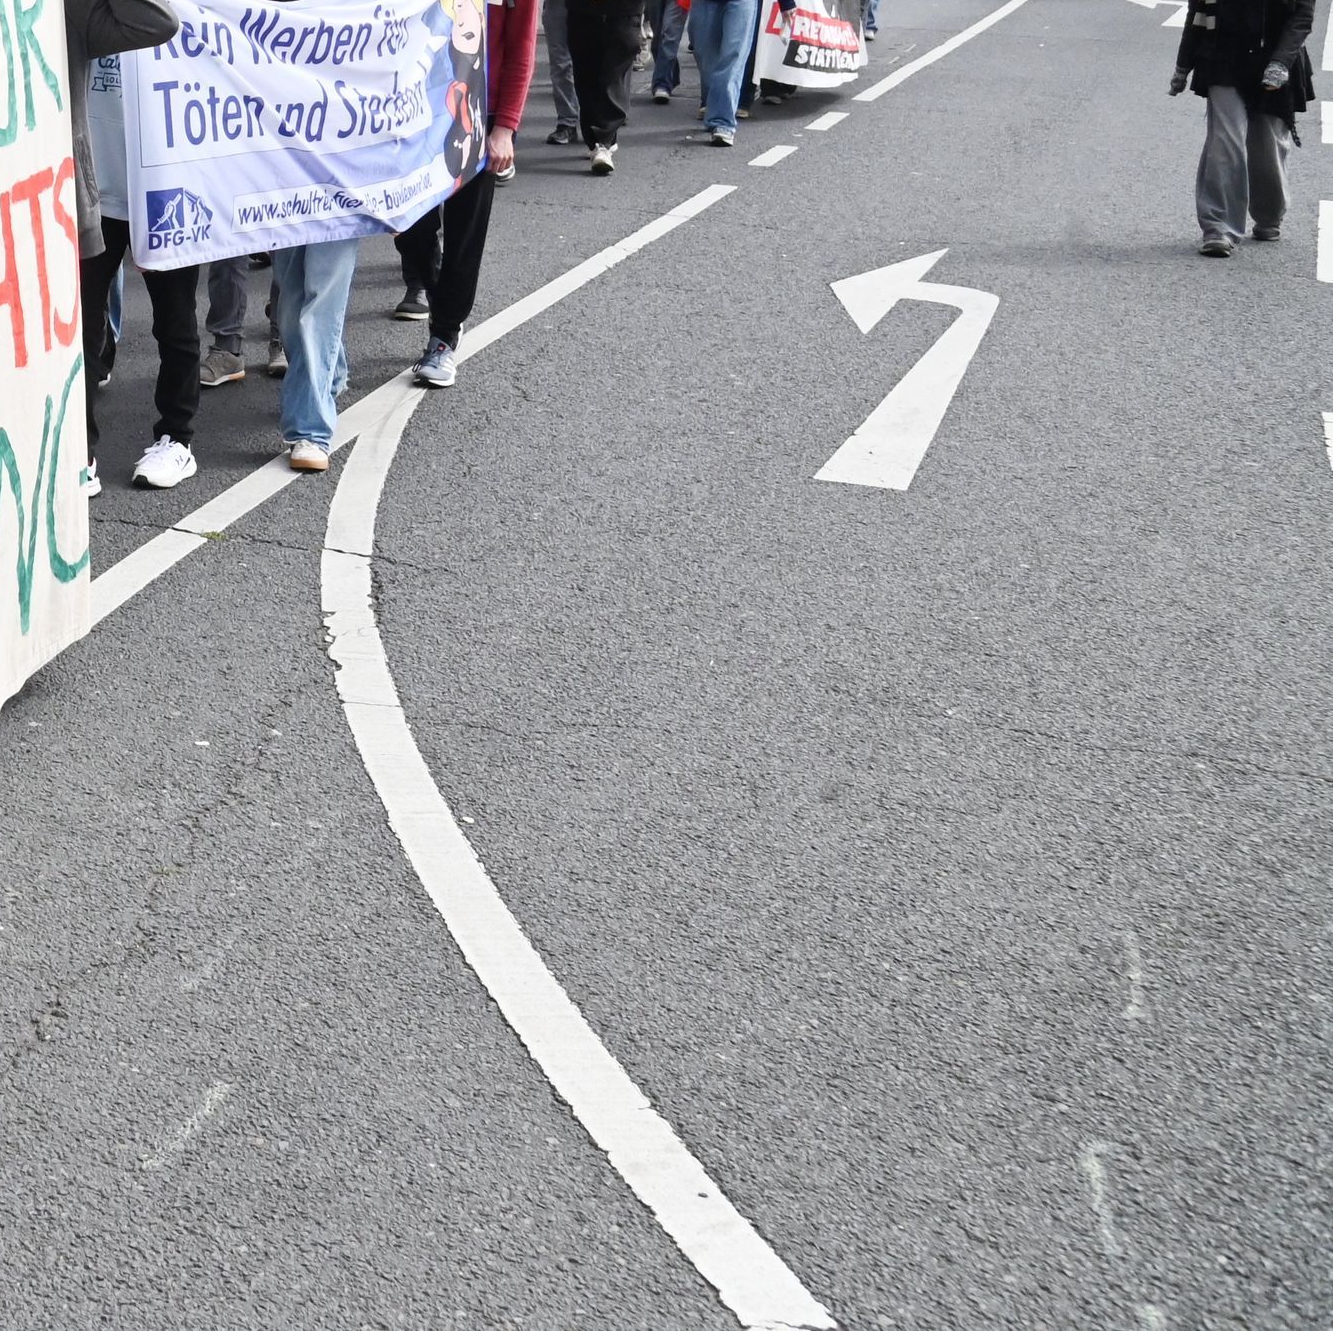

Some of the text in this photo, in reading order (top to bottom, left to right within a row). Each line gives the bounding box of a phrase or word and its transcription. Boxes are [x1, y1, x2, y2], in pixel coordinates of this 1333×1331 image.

[240, 8, 372, 65] Werben
[153, 80, 264, 148] Töten
[148, 224, 213, 250] DFG-VK
